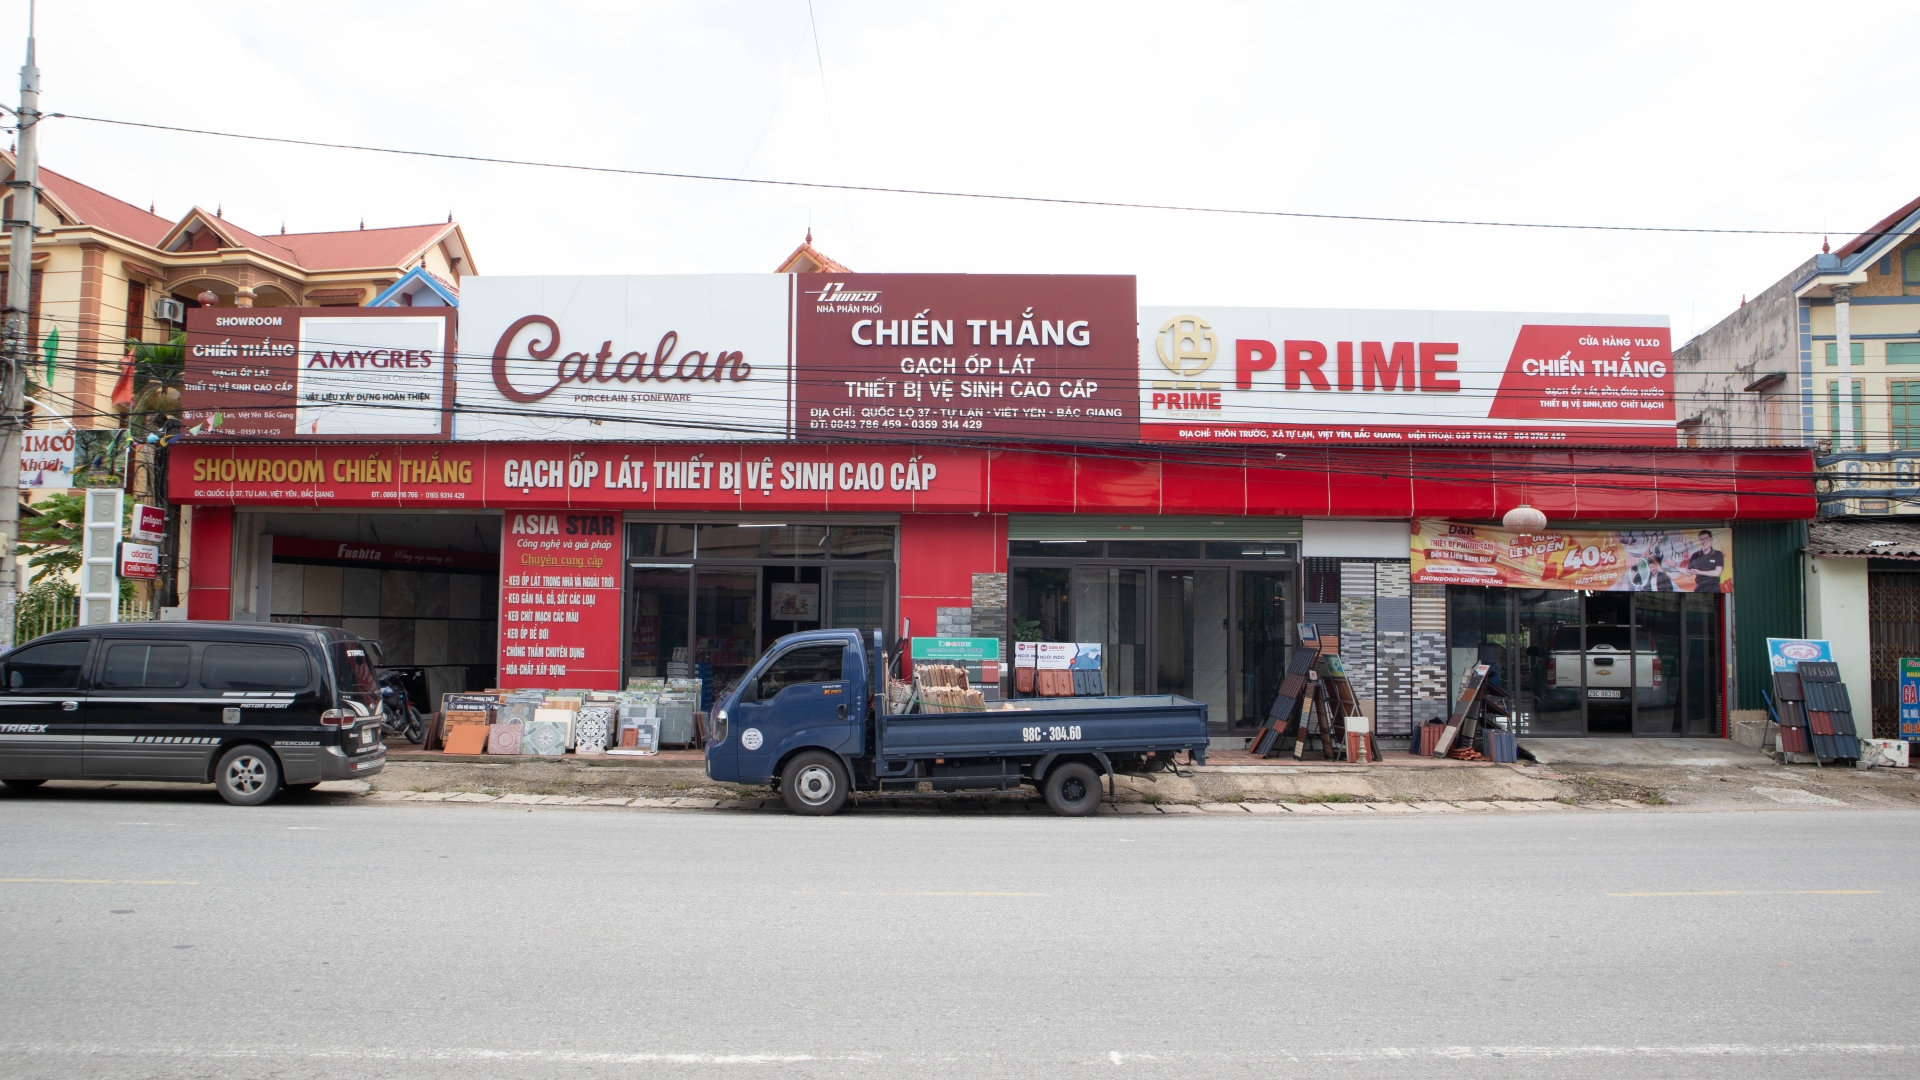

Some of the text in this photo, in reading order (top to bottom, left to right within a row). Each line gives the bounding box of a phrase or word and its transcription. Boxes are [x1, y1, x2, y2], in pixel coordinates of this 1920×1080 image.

[816, 303, 882, 313] NHÀ PHÂN PHỐI
[216, 317, 282, 326] SHOWROOM
[851, 306, 1090, 346] CHIẾN THẮNG
[193, 337, 295, 356] CHIẾN THẮNG
[1579, 335, 1660, 347] CỬA HÀNG VLXD
[307, 350, 432, 368] AMYGRES
[491, 314, 751, 403] Catalan
[901, 354, 1035, 377] GẠCH ỐP LÁT
[1236, 339, 1460, 392] PRIME
[1522, 350, 1666, 378] CHIẾN THẮNG
[275, 381, 293, 391] CẤP
[845, 377, 1098, 402] THIẾT BỊ VỆ SINH CAO CẤP
[306, 393, 319, 402] VẬT
[340, 392, 354, 400] XÂY
[383, 392, 405, 400] HOÀN
[407, 392, 430, 401] THIỆN
[574, 393, 691, 403] PORCELAIN STONEWARE
[1153, 393, 1221, 410] PRIME
[1540, 398, 1580, 409] THIẾT BỊ VỆ
[993, 407, 1018, 418] VIỆT
[1620, 400, 1664, 410] CHÍT MẠCH
[810, 406, 930, 420] ĐỊA CHỈ: QUỐC LỘ 37
[1086, 409, 1122, 417] GIANG
[830, 420, 901, 428] 0843 786 459
[912, 420, 982, 428] 0359 314 429
[1214, 429, 1333, 440] THÔN TRƯỚC, VIỆT
[193, 451, 472, 484] SHOWROOM CHIẾN THẮNG
[504, 452, 937, 496] GẠCH ỐP LÁT, THIẾT BỊ VỆ SINH CAO CẤP
[207, 488, 225, 497] QUỐC
[301, 488, 313, 497] BẮC
[142, 514, 162, 527] poligon
[512, 515, 615, 535] ASIA STAR
[517, 539, 611, 550] Công nghệ và giải pháp
[1536, 539, 1564, 554] ĐẾN
[131, 550, 152, 559] atlantic
[521, 553, 603, 568] Chuyên cung cấp
[1564, 545, 1615, 569] 40%
[127, 563, 140, 572] CHIẾN
[509, 571, 614, 587] KEO ỐP LÁT TRONG NHÀ VÀ NGOÀI TRỜI
[509, 590, 596, 607] KEO GẮN SẮT CÁC LOẠI
[508, 609, 579, 624] KEO CHÍT MẠCH CÁC MÀU
[507, 628, 518, 639] KEO
[520, 624, 528, 639] ỐP
[539, 628, 549, 639] BƠI
[506, 643, 584, 660] CHỐNG THẤM CHUYÊN DỤNG
[506, 662, 518, 675] HÓA
[520, 660, 534, 675] CHẤT
[536, 663, 547, 675] XÂY
[1022, 726, 1081, 742] 98C 304.60
